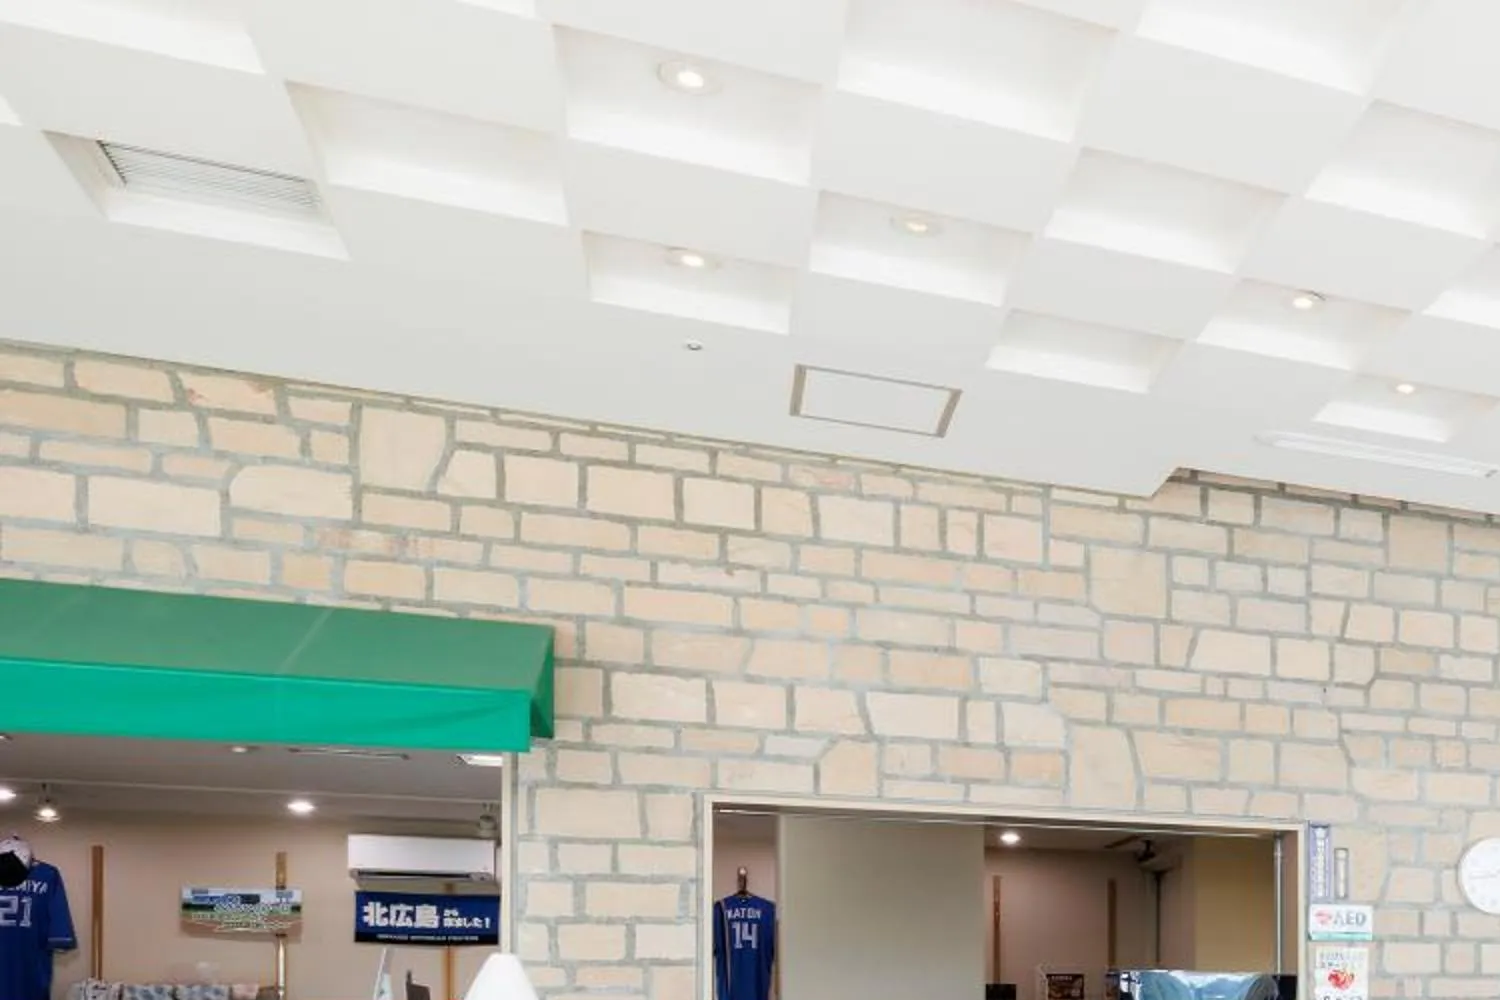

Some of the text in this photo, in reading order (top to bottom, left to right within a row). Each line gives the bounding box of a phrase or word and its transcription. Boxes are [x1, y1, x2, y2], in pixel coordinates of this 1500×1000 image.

[363, 901, 440, 928] 北広島
[732, 921, 758, 949] 14
